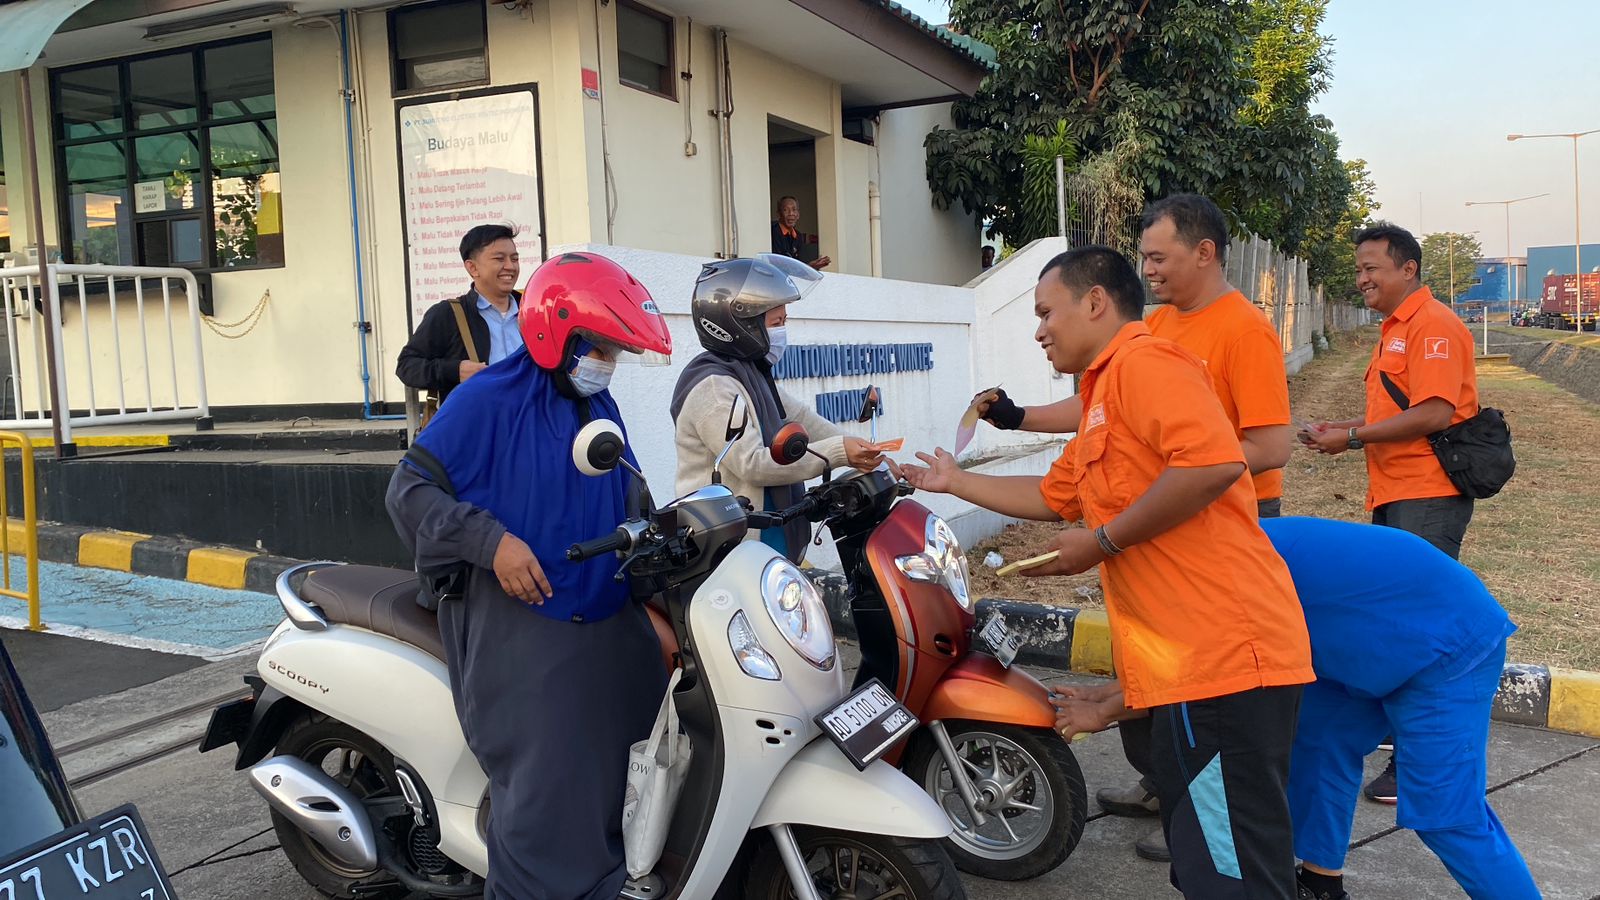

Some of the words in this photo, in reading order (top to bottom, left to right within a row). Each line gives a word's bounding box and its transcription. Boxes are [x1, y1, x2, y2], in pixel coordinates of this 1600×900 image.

[428, 137, 475, 151] Budaya
[478, 131, 509, 146] Malu
[418, 185, 433, 194] Malu
[434, 183, 455, 194] Datang
[456, 181, 486, 191] Terlambat
[419, 201, 434, 210] Malu
[435, 199, 455, 210] Sering
[466, 196, 488, 207] Pulang
[489, 194, 506, 204] Lebih
[507, 192, 523, 201] Awal
[420, 216, 434, 225] Malu
[436, 213, 470, 225] Berpakaian
[471, 211, 487, 220] Tidak
[488, 210, 503, 220] Rapi
[421, 231, 436, 241] Malu
[437, 230, 453, 239] Tidak
[422, 247, 437, 255] Malu
[423, 262, 438, 270] Malu
[424, 277, 438, 285] Malu
[425, 292, 439, 300] Malu
[702, 320, 728, 339] INK
[842, 343, 896, 376] ELECTRIC
[896, 343, 934, 372] WINTEC
[268, 660, 330, 694] SCOOPY
[828, 716, 852, 739] AD
[843, 698, 877, 727] 5100
[65, 827, 146, 893] KZR
